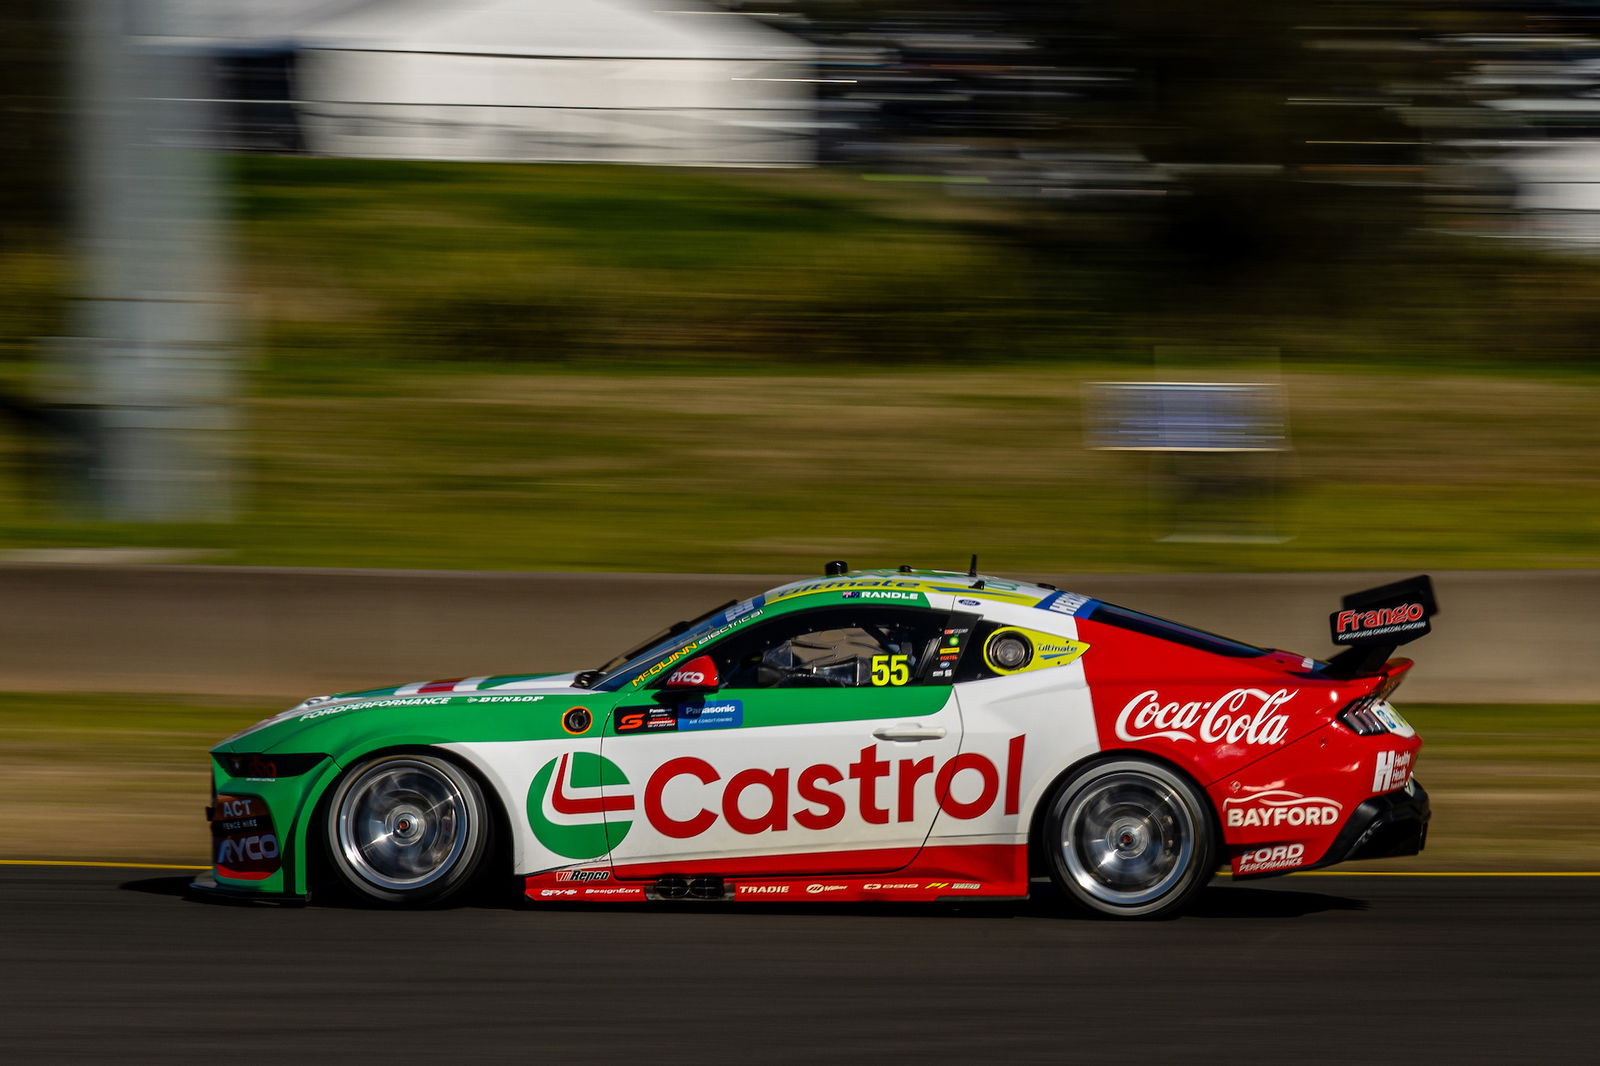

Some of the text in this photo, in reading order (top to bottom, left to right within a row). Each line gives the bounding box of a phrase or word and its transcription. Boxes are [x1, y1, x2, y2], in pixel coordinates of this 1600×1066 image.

[861, 591, 918, 600] RANDLE
[1336, 602, 1424, 633] Frango
[699, 609, 764, 645] electrical
[1038, 643, 1078, 653] ultimate
[670, 671, 705, 684] RYCO
[871, 654, 909, 687] 55
[478, 695, 545, 703] DUNLOP
[686, 704, 736, 715] Panasonic
[1114, 687, 1300, 746] Coca-Cola
[643, 733, 1026, 839] Castrol
[223, 800, 252, 817] ACT
[1227, 806, 1340, 827] BAYFORD
[1240, 843, 1305, 865] FORD
[1239, 857, 1303, 872] PERFORMANCE
[570, 869, 611, 883] Repco
[739, 885, 790, 894] TRADIE
